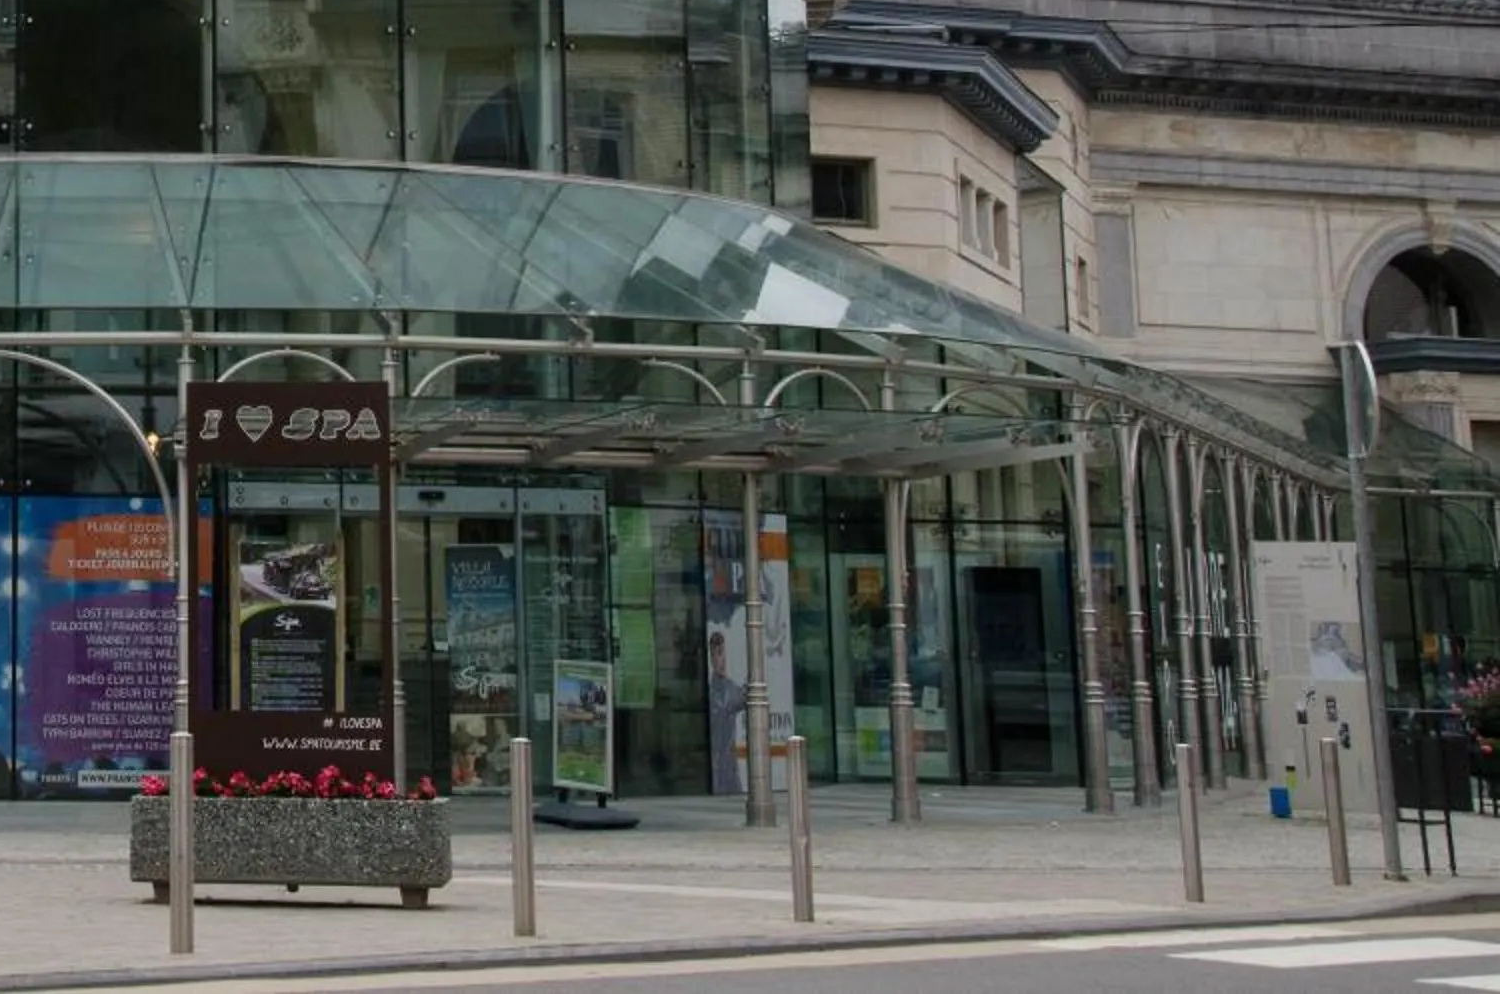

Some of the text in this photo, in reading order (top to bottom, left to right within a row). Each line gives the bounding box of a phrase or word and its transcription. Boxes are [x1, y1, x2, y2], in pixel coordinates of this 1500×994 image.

[200, 407, 381, 440] I SPA
[261, 736, 383, 751] WWW.SPATOURISME.BE
